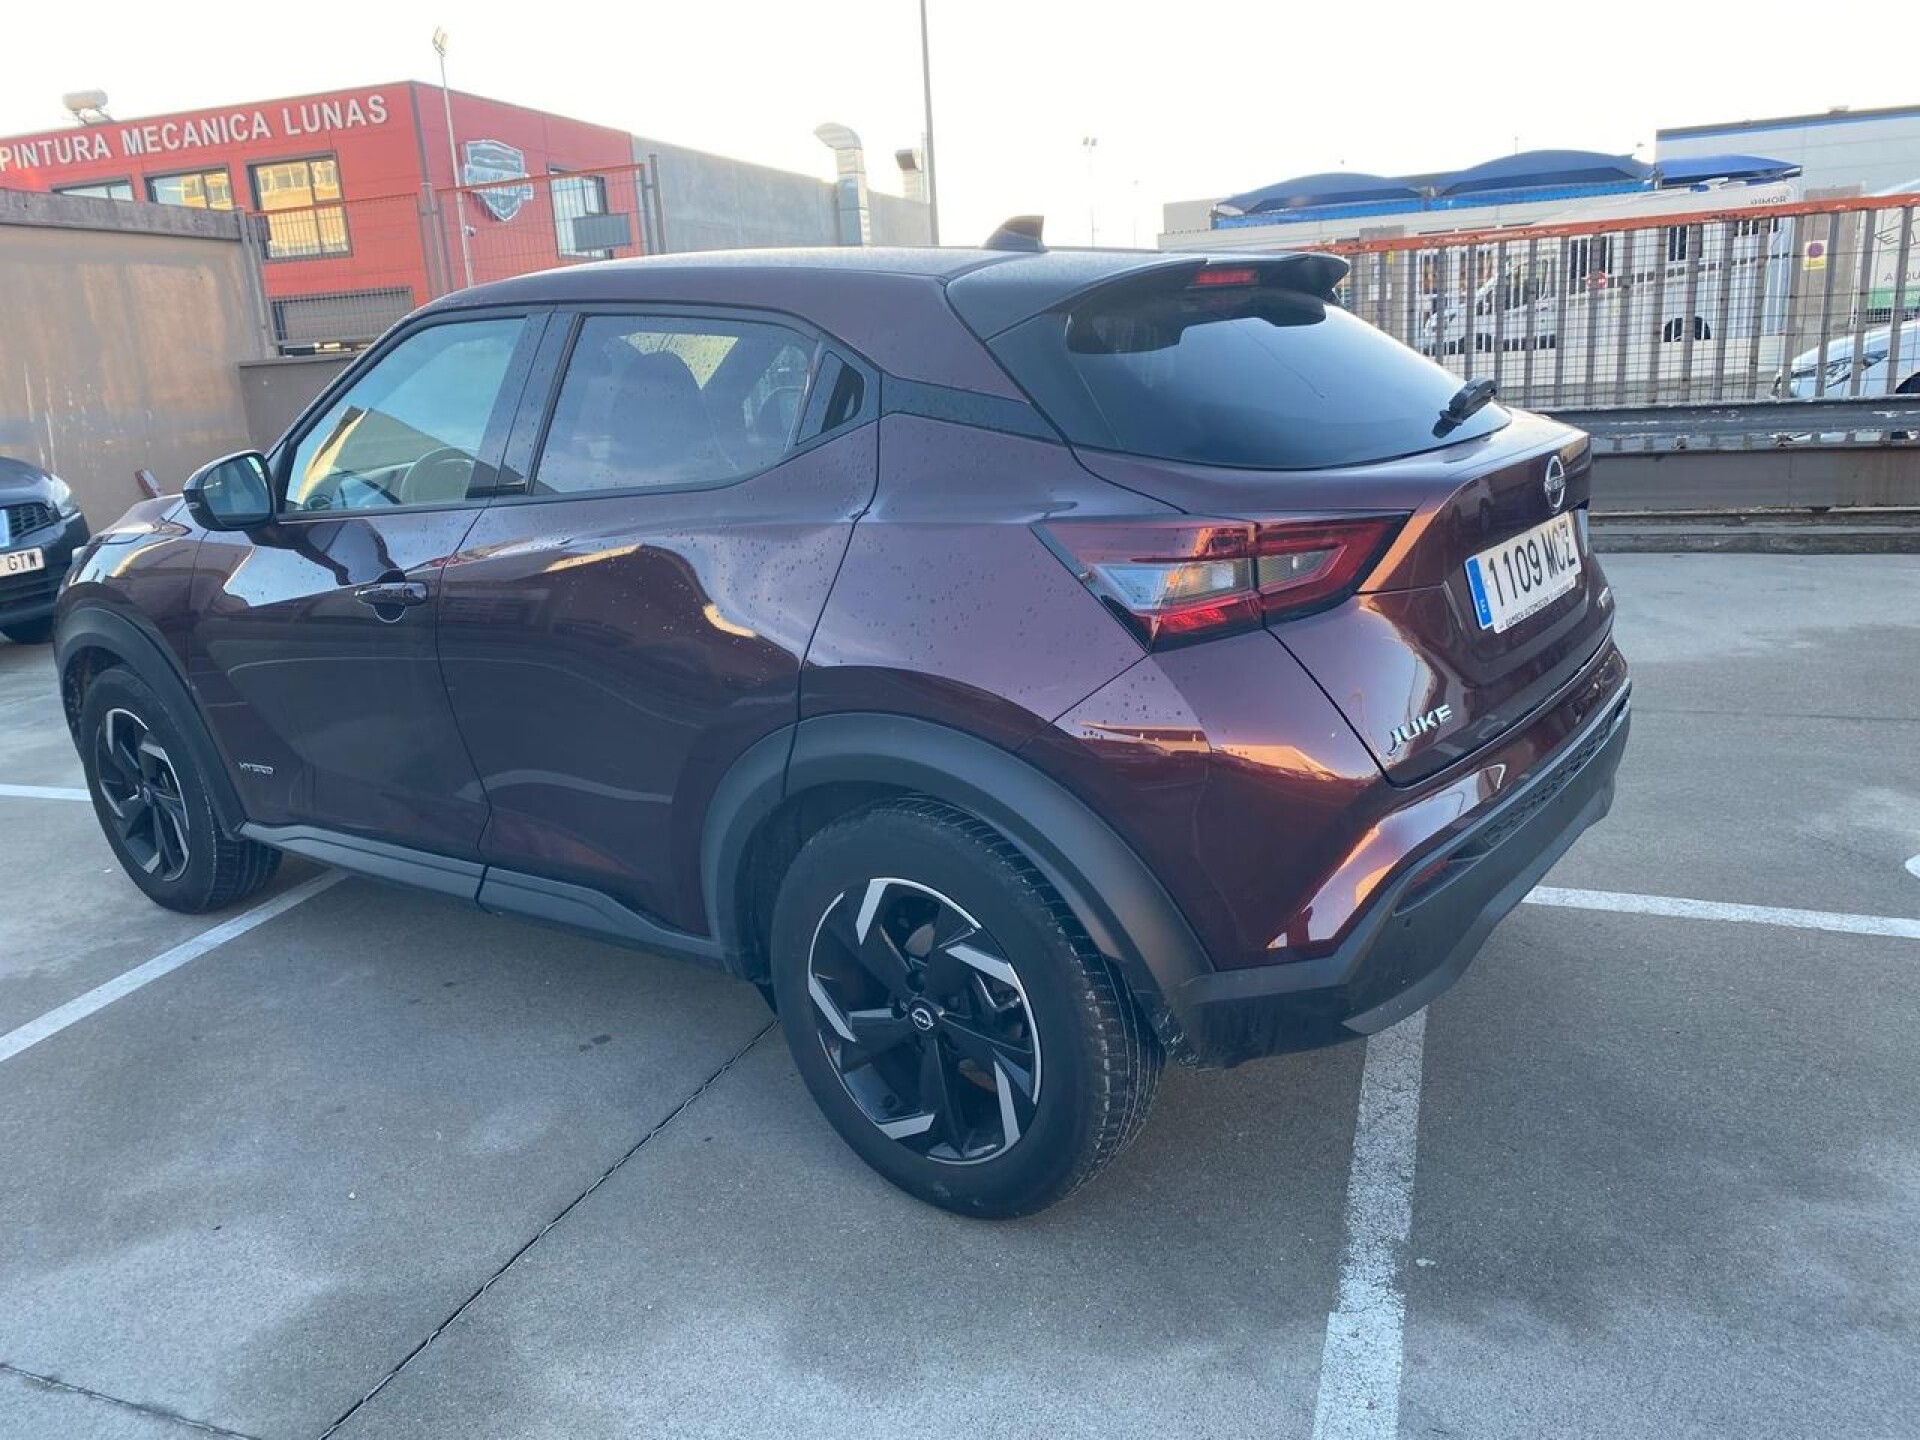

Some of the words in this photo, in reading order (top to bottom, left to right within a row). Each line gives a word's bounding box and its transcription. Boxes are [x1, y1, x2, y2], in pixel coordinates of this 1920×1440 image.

[0, 134, 111, 171] PINTURA
[121, 112, 270, 155] MECANICA
[282, 94, 389, 136] LUNAS
[1488, 539, 1543, 607] 1109
[1541, 523, 1576, 579] MCZ
[1388, 704, 1453, 756] JUKE
